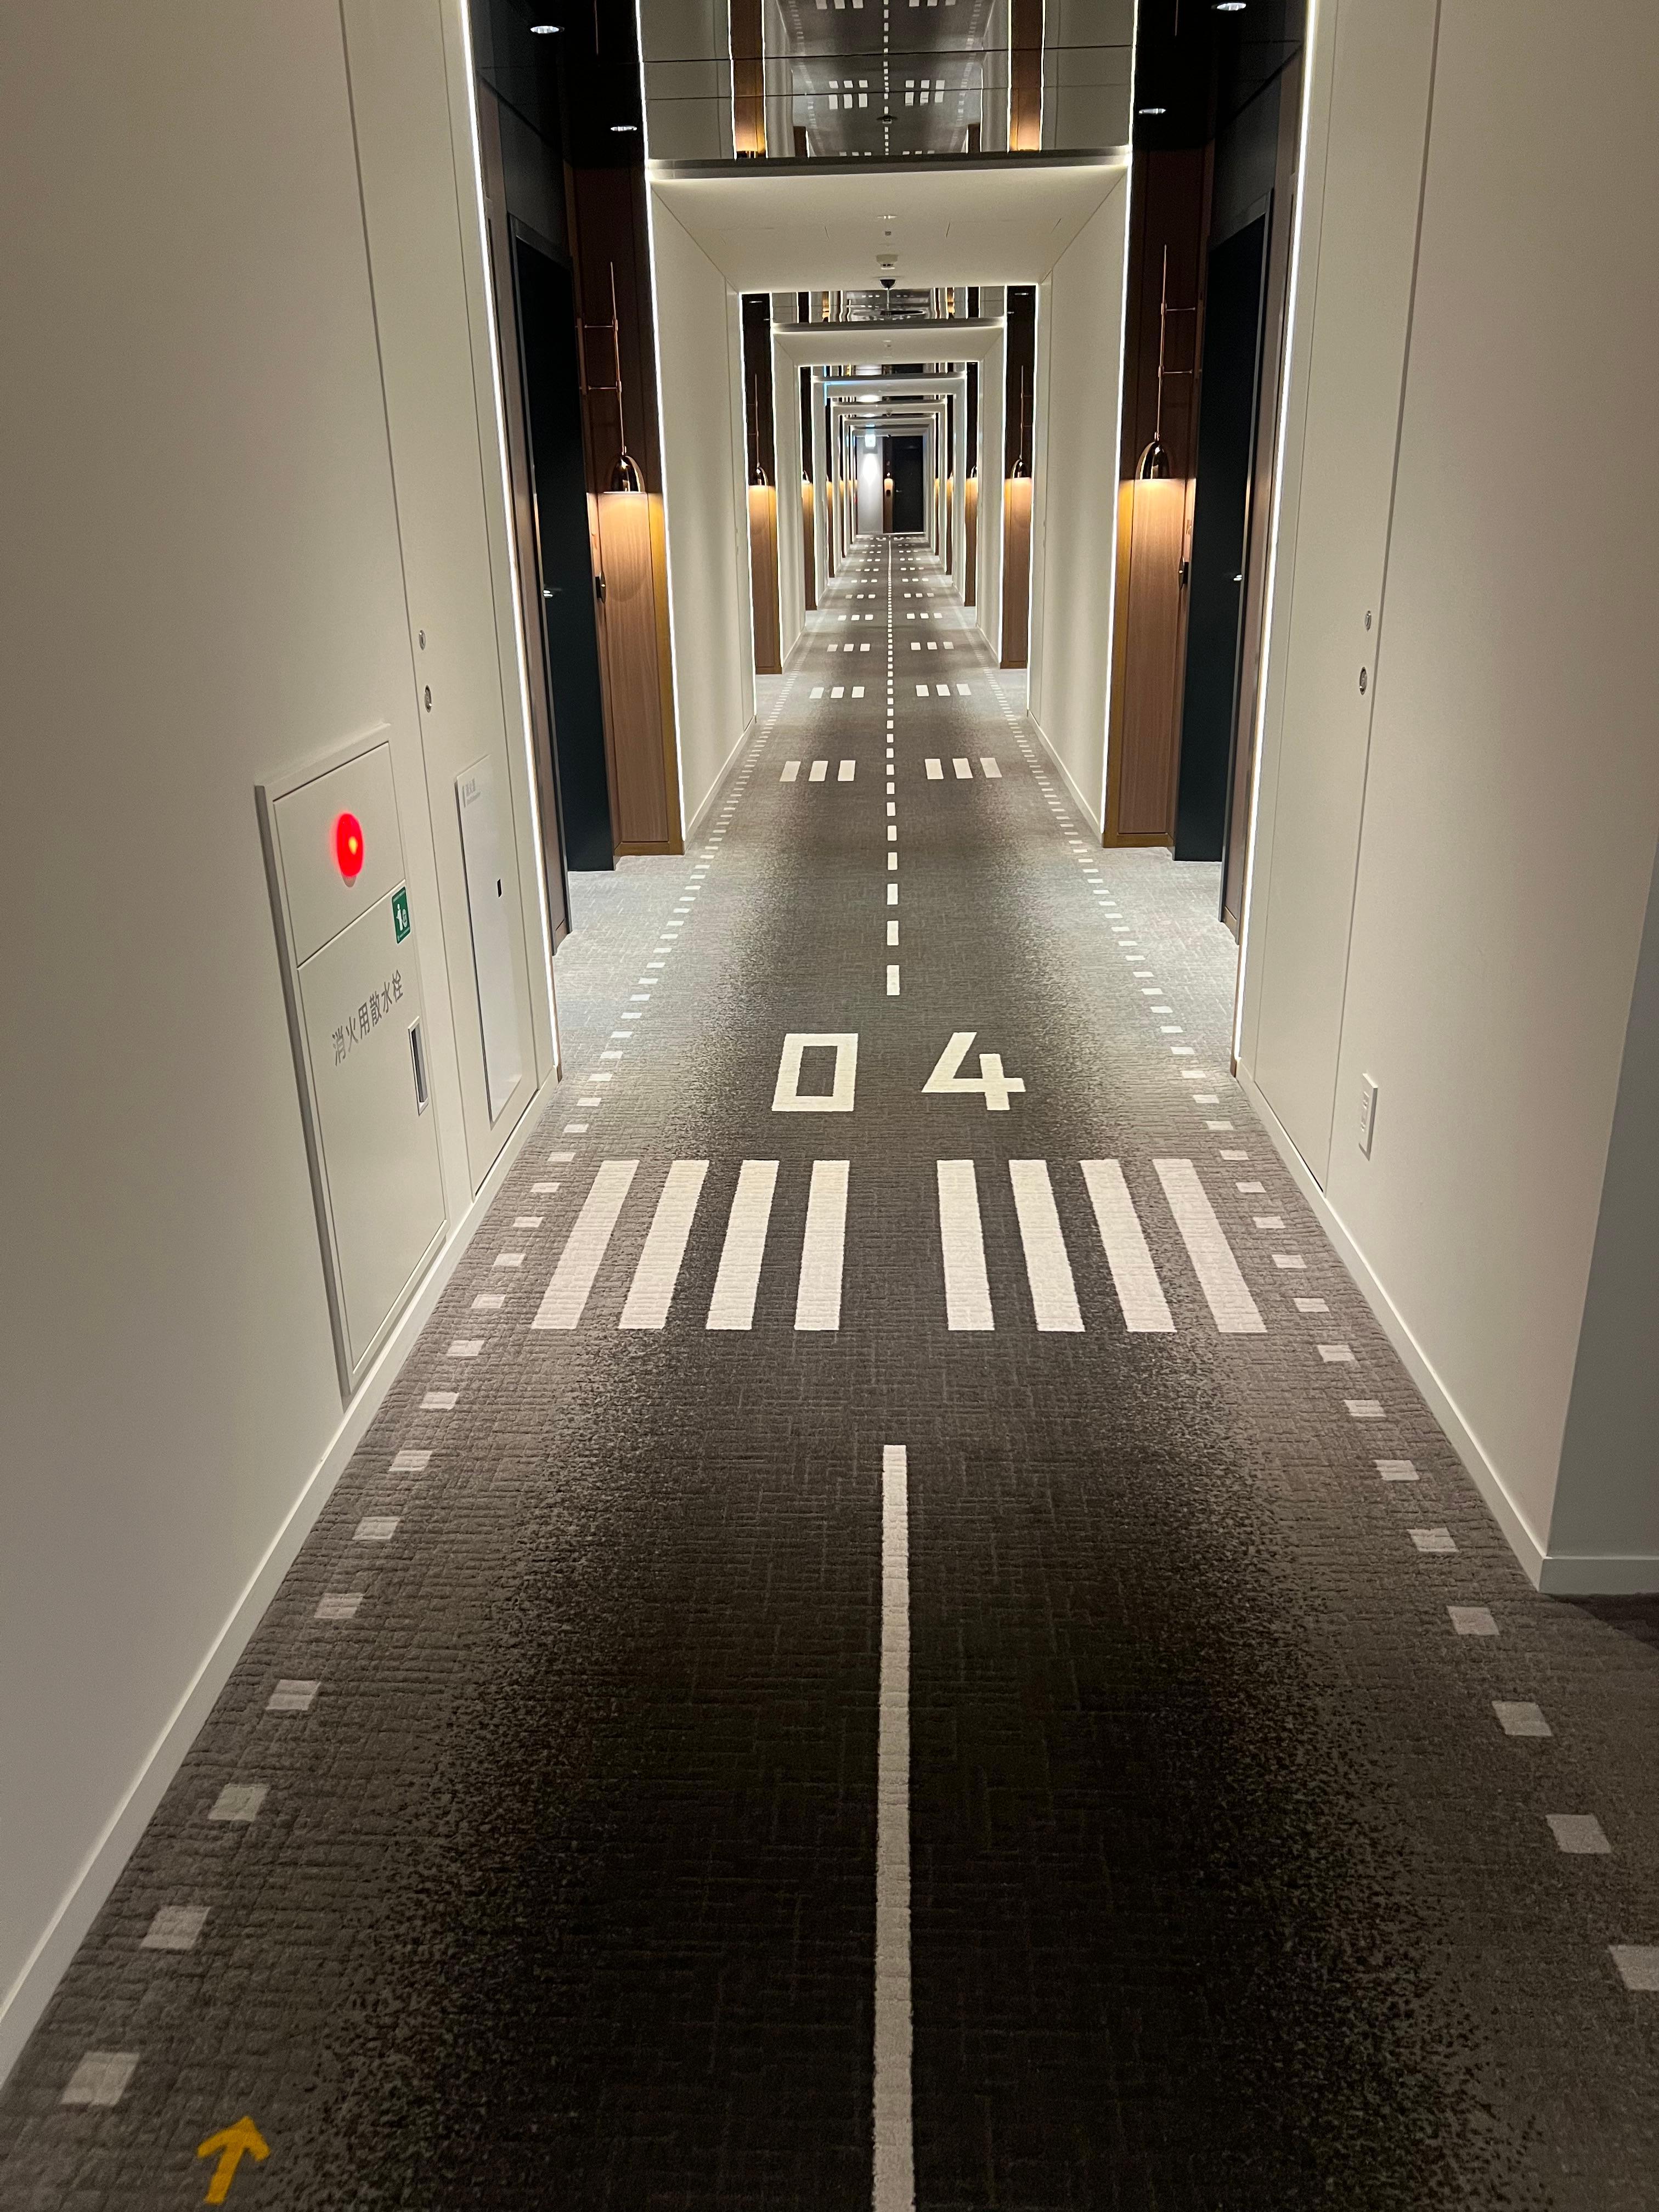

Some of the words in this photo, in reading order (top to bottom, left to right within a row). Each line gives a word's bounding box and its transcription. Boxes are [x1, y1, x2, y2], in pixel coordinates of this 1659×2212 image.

[332, 969, 403, 1066] 消火用散水栓
